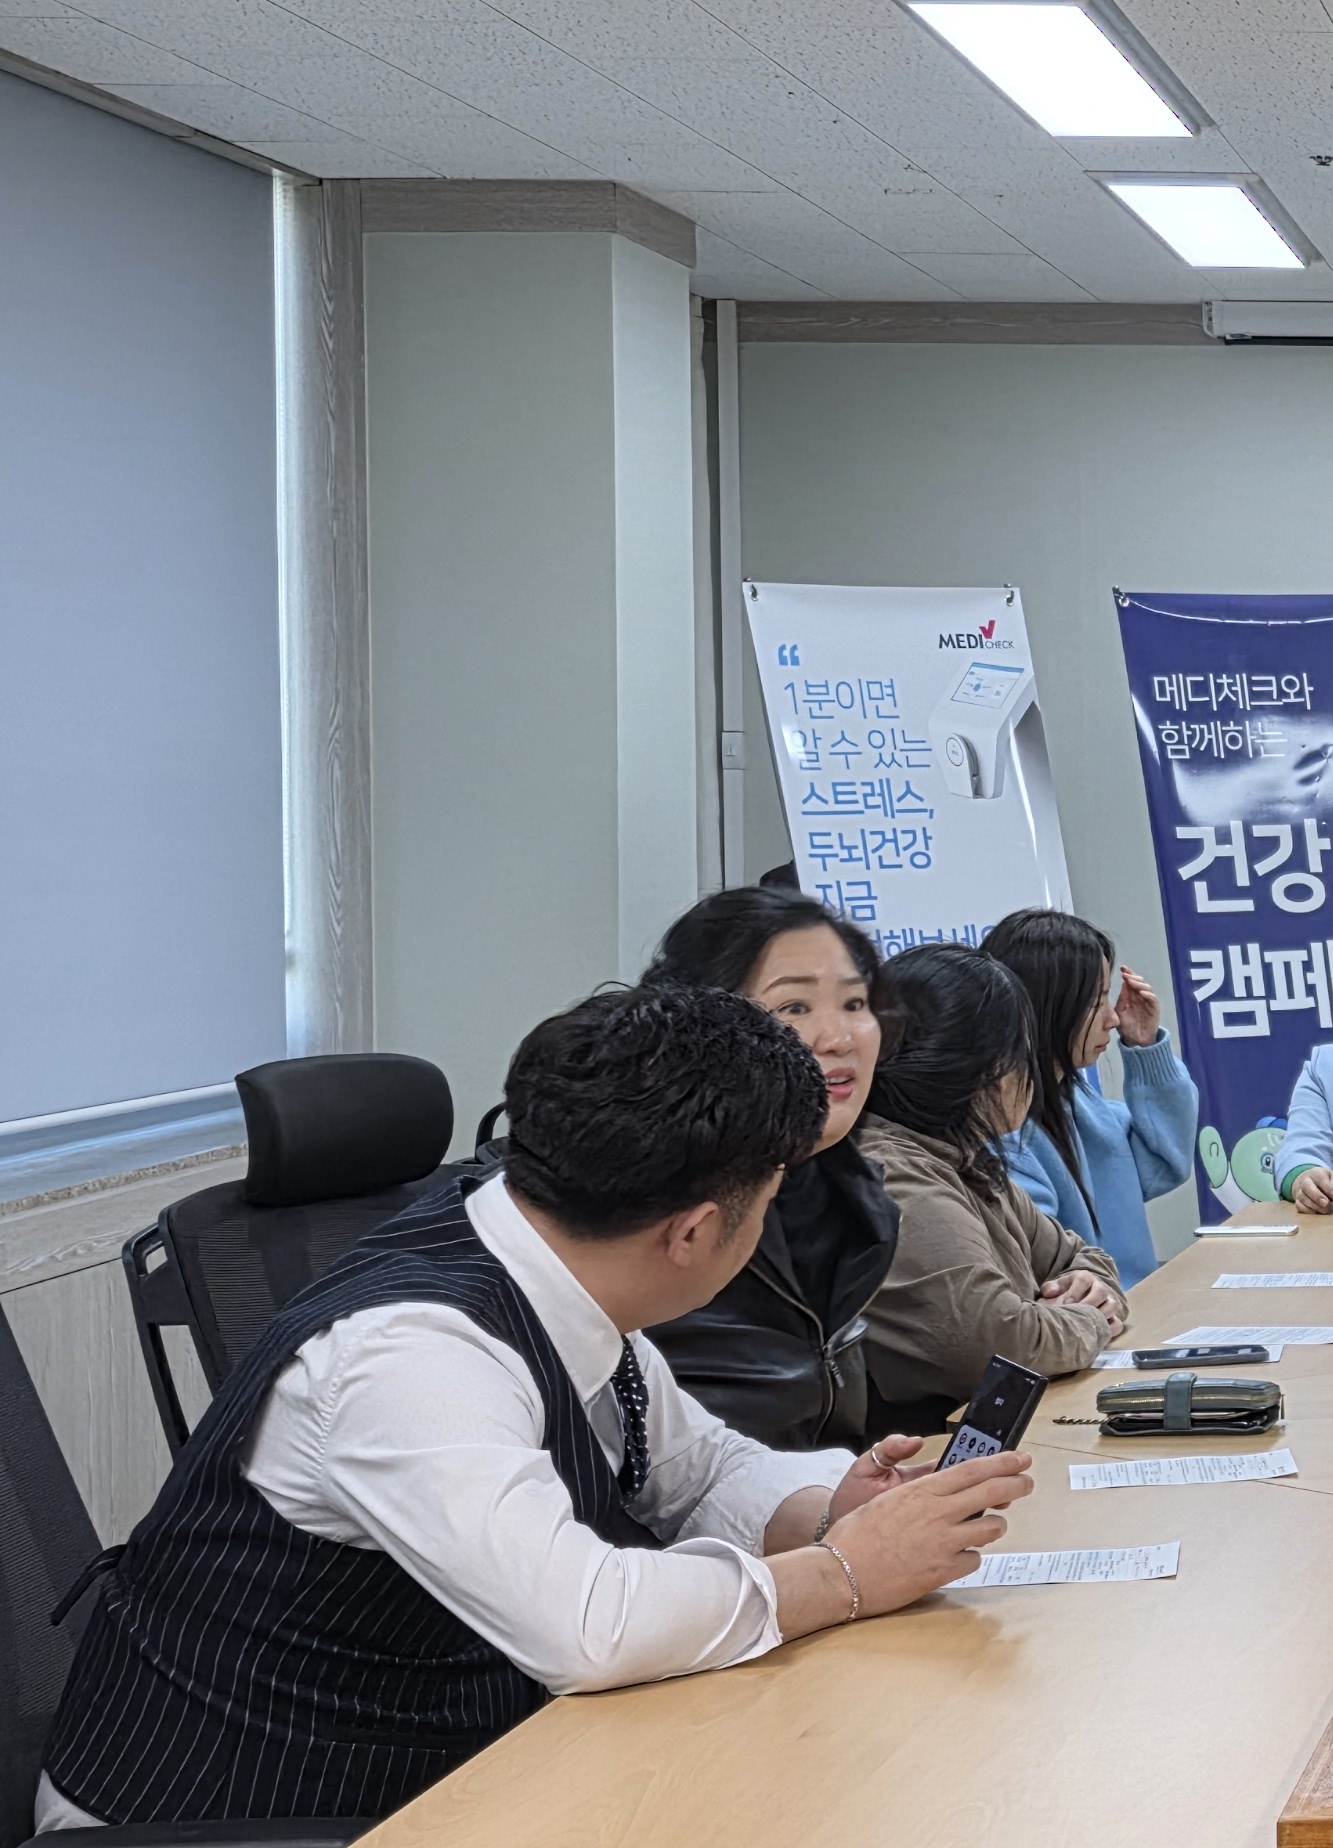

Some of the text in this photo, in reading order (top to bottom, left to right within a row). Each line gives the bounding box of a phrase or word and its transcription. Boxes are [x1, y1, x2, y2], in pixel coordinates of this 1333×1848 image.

[784, 678, 900, 720] 1분이면
[1153, 672, 1314, 711] 메디체크와
[791, 728, 933, 771] 알 수 있는
[1158, 720, 1288, 759] 함께하는
[801, 777, 934, 820] 스트레스,
[808, 826, 933, 872] 두뇌건강
[1176, 818, 1332, 914] 건강
[815, 880, 878, 922] 지금
